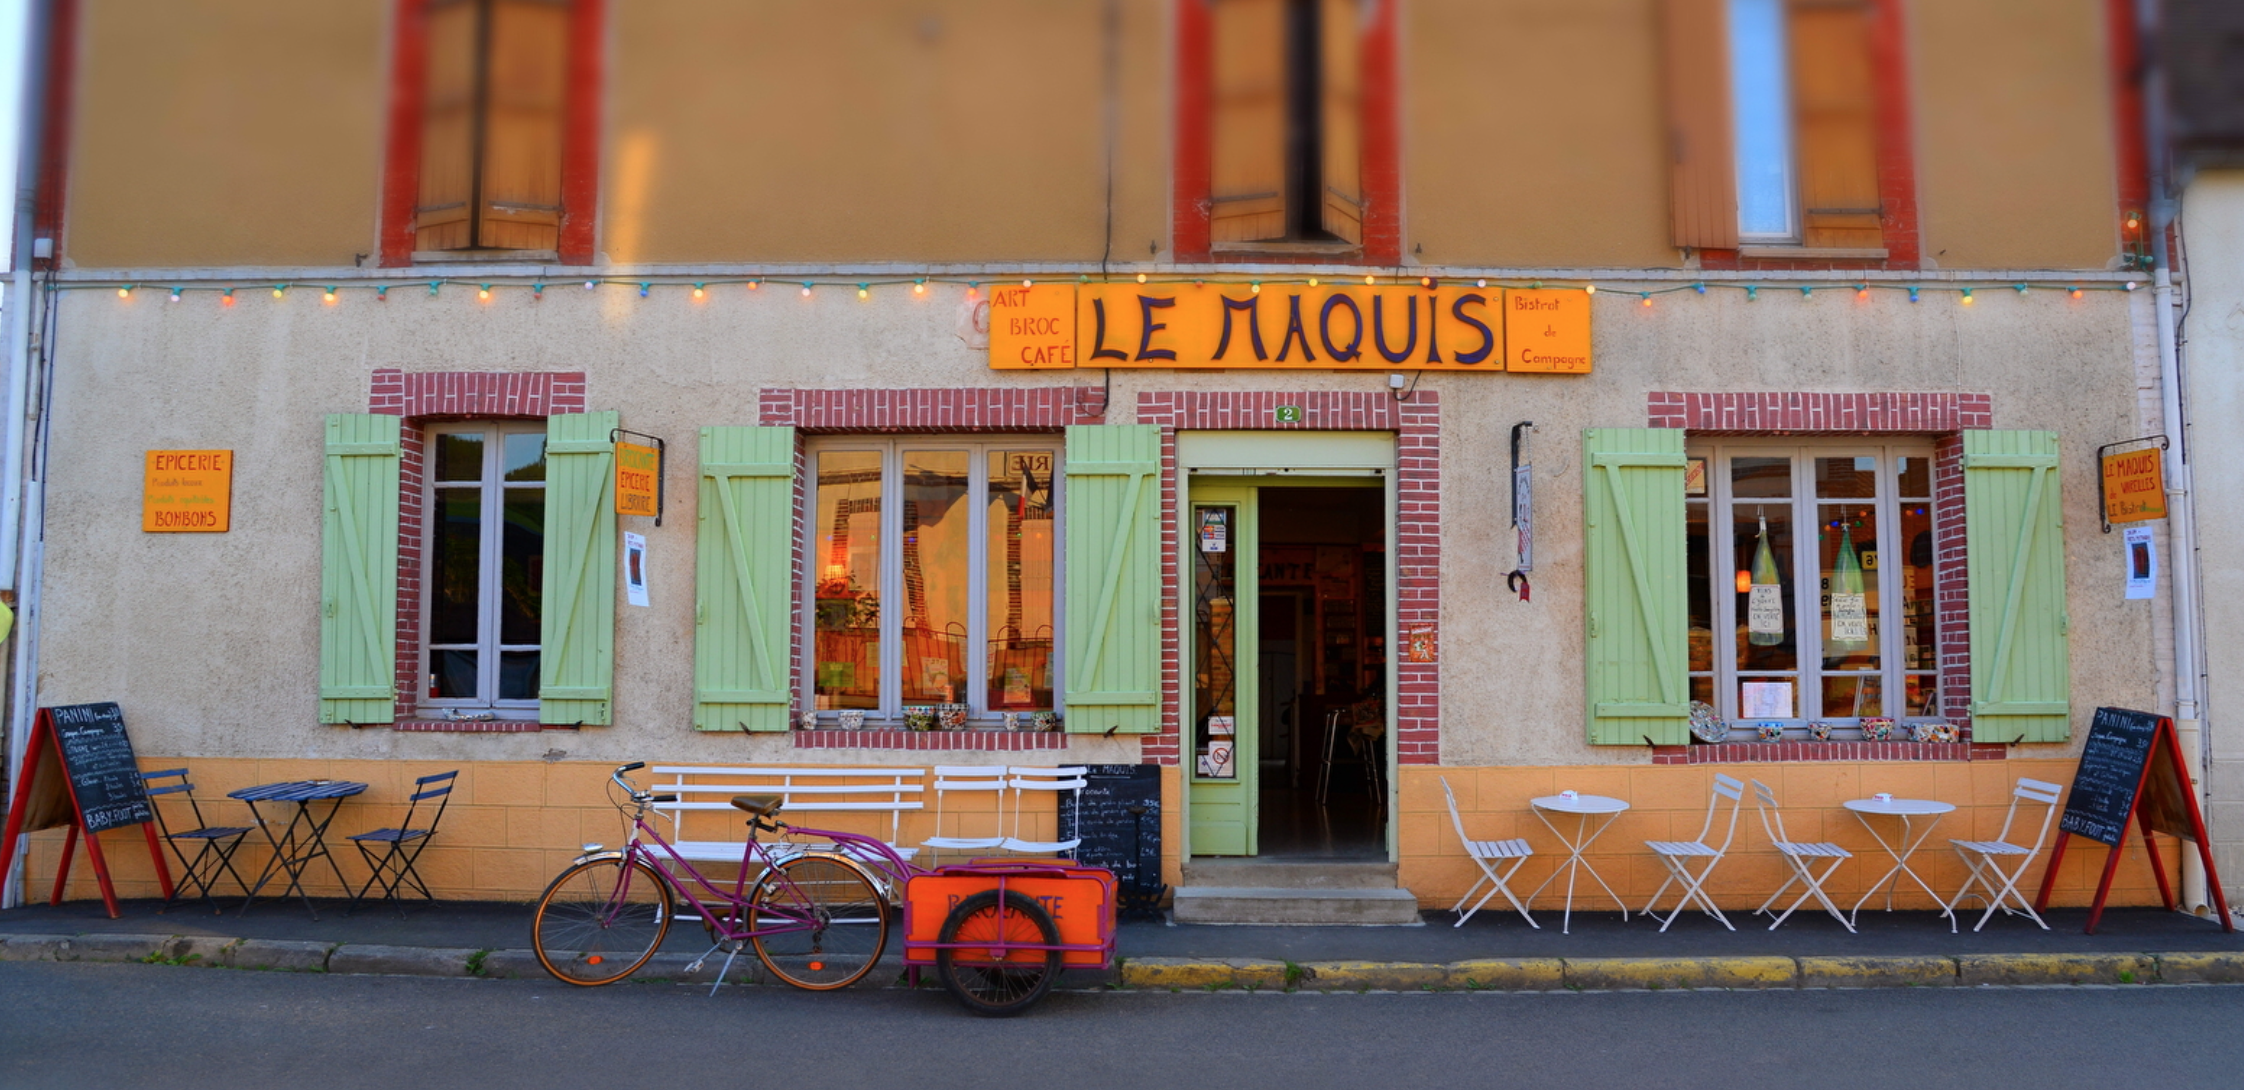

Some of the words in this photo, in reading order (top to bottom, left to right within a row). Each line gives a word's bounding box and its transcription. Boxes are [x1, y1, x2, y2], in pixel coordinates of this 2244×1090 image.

[993, 290, 1030, 307] ART
[1515, 296, 1560, 310] Bistrot
[1010, 317, 1060, 335] BROC
[1090, 295, 1177, 361] LE
[1211, 293, 1494, 364] MAQUIS
[1544, 324, 1557, 337] de
[1021, 339, 1072, 364] CAFÉ
[1521, 348, 1587, 369] Campagne
[1284, 408, 1293, 420] 2
[2105, 464, 2115, 477] LE
[2117, 455, 2154, 478] MAQUIS
[154, 511, 217, 527] BONBONS
[55, 708, 95, 723] PANINI
[2097, 710, 2132, 730] PANINI
